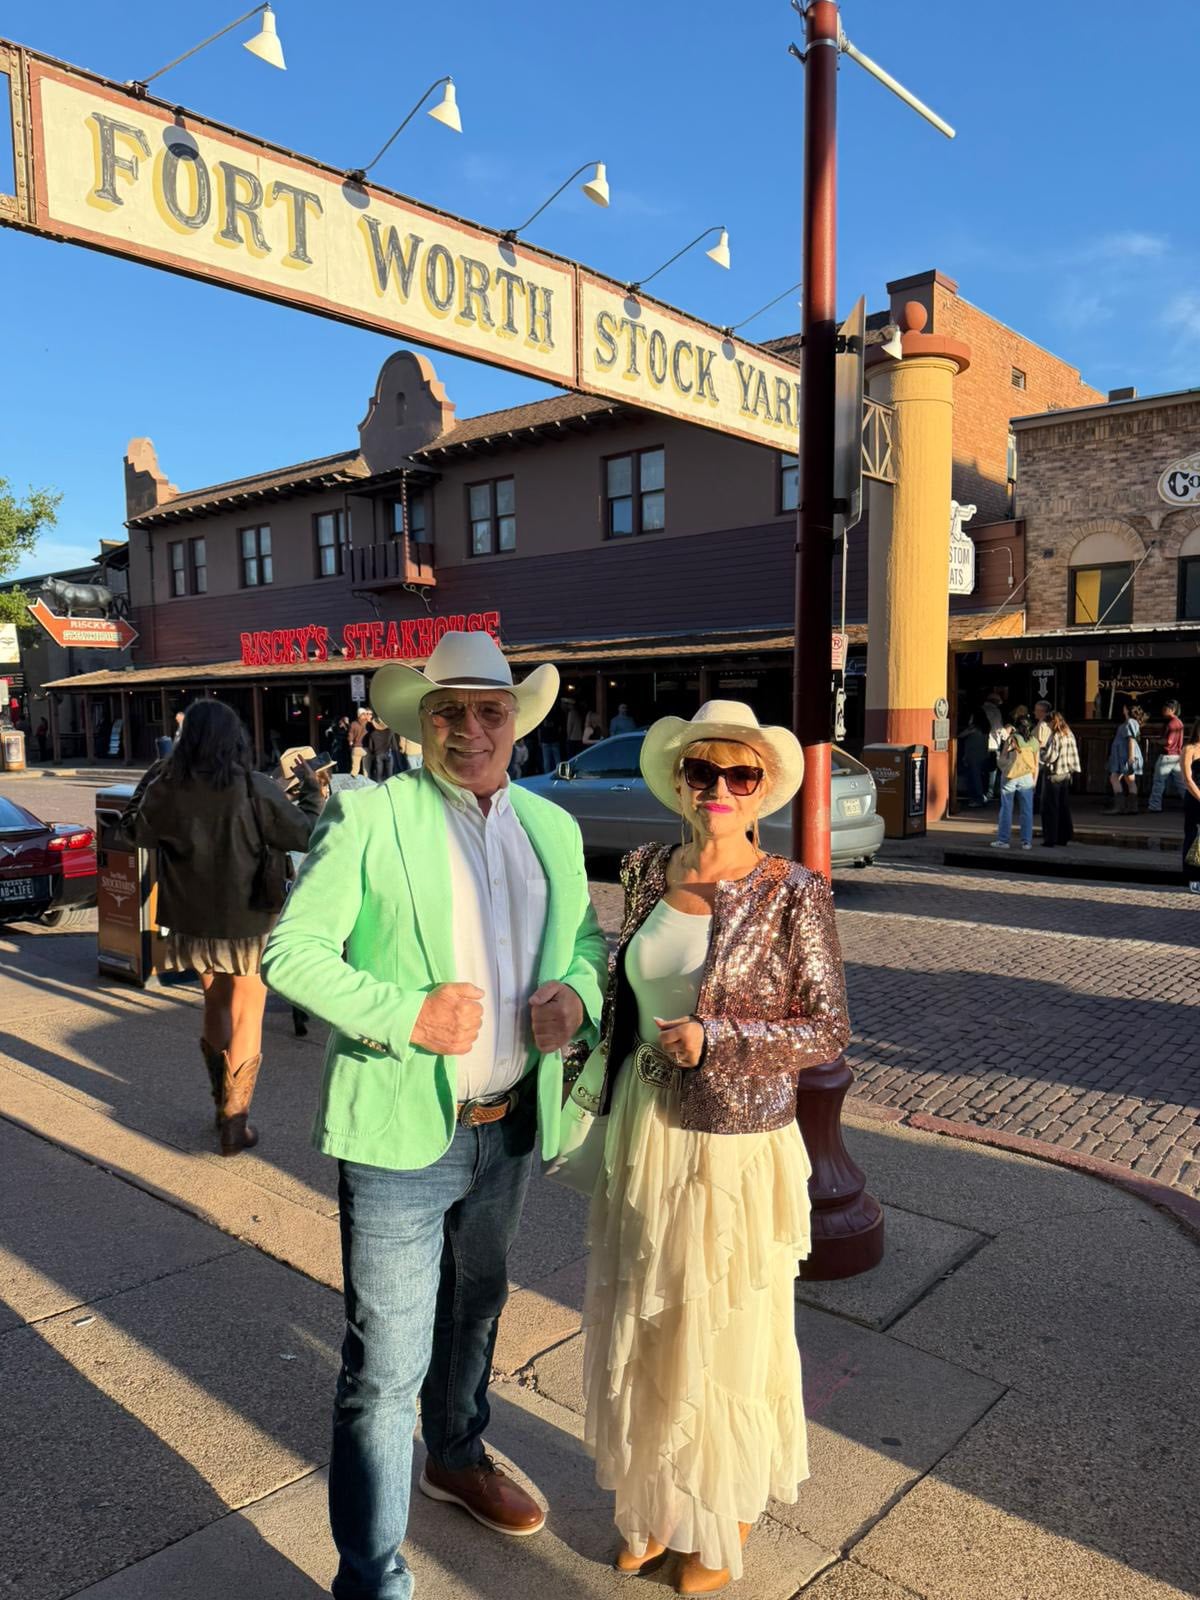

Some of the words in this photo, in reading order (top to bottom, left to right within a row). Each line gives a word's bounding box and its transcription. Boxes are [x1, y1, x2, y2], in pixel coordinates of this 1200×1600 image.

[86, 112, 324, 270] FORT
[360, 214, 555, 352] WORTH
[594, 311, 720, 407] STOCK
[733, 358, 801, 433] YAR
[949, 547, 970, 564] STOM
[949, 568, 964, 586] ATS
[70, 620, 116, 630] RISCKY'S
[240, 624, 329, 666] RISCKY'S
[1012, 646, 1073, 662] WORLDS
[1108, 643, 1154, 659] FIRST
[1032, 669, 1055, 677] OPEN
[1098, 678, 1175, 689] STOCKYARDS
